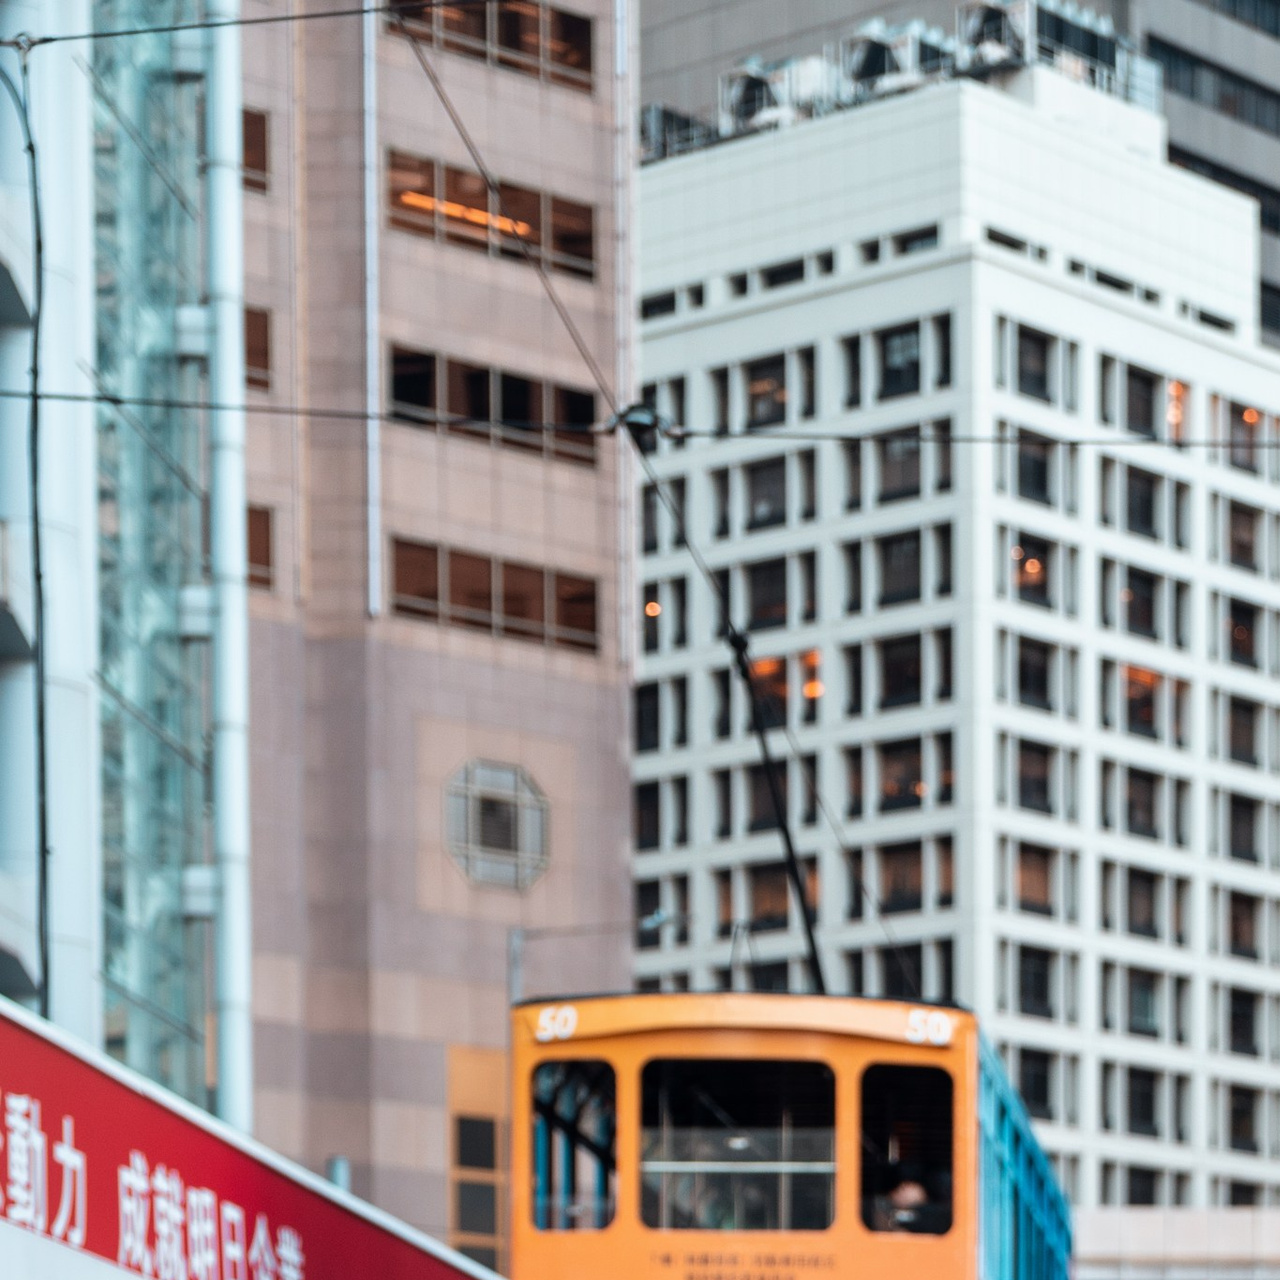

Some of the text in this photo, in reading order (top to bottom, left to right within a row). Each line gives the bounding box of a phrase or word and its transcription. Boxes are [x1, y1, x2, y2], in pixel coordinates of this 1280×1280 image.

[536, 1006, 578, 1042] 50
[905, 1009, 952, 1046] 50
[0, 1090, 87, 1248] 動力
